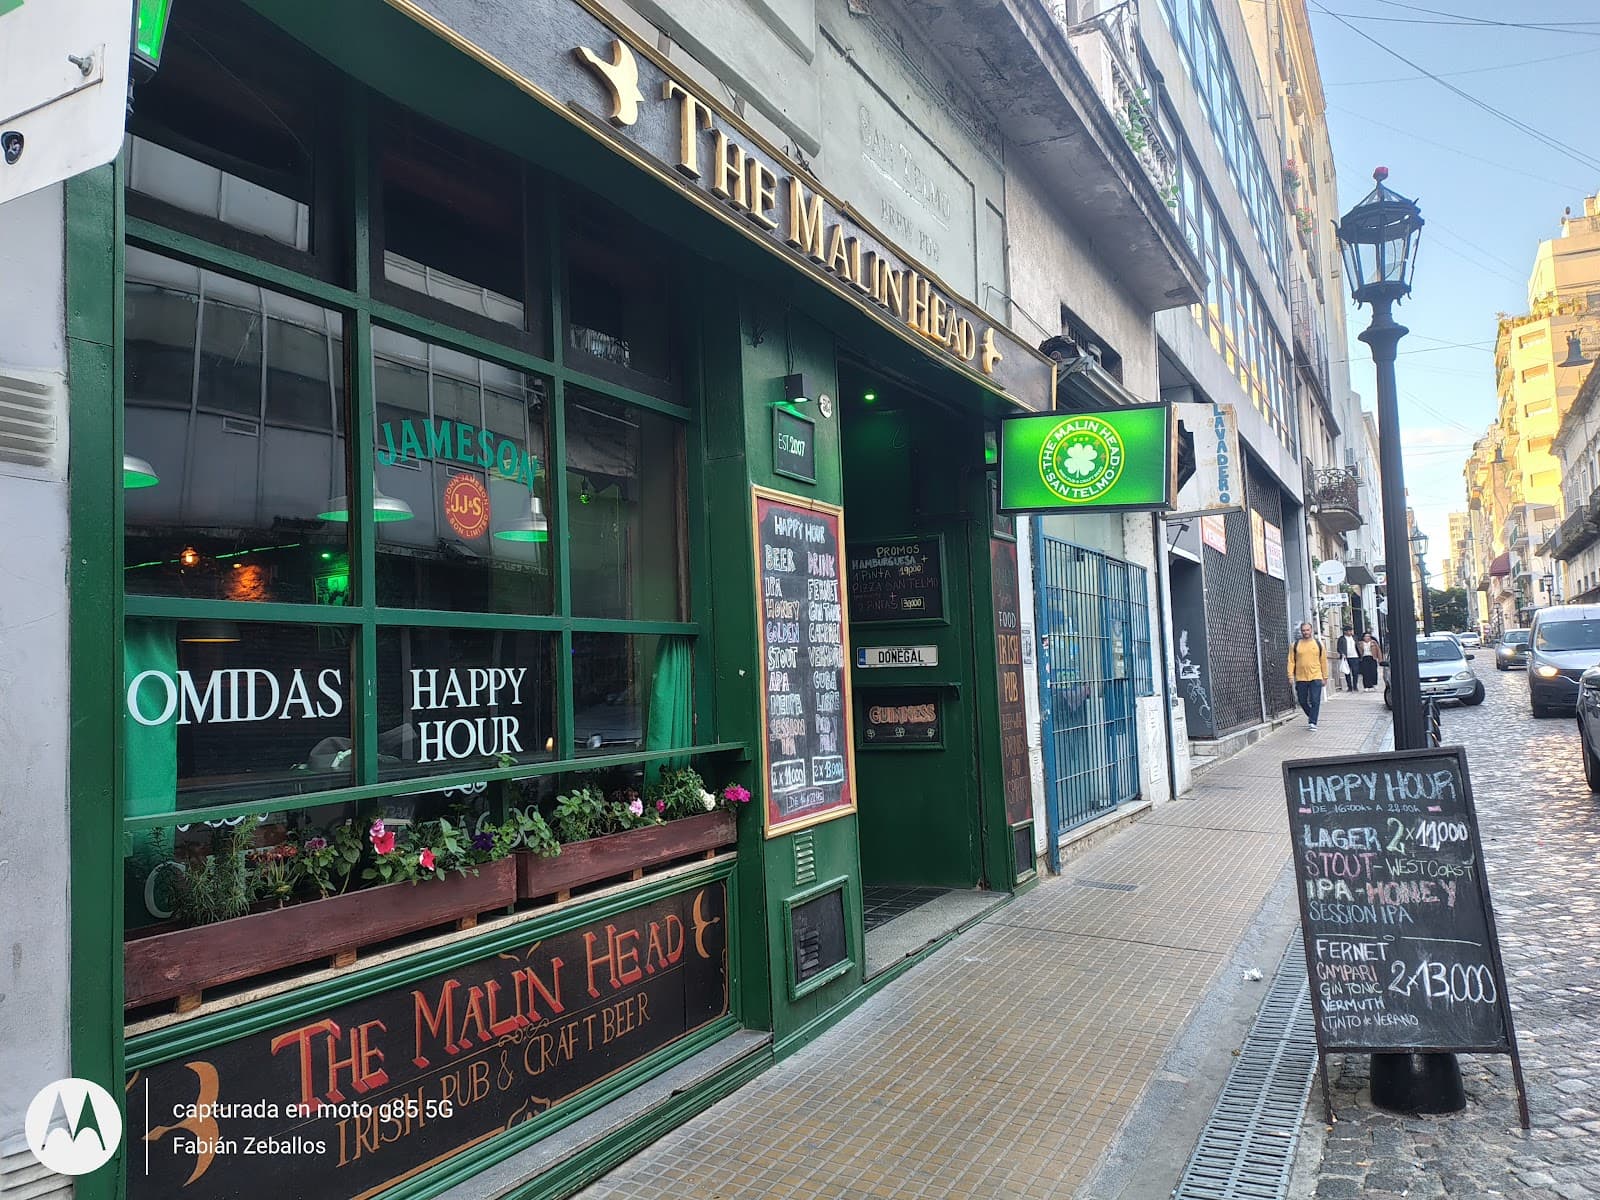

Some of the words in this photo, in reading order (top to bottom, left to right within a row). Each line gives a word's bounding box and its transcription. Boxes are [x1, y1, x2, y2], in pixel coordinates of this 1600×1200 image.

[662, 80, 778, 230] THE
[784, 175, 904, 317] MALIN
[905, 268, 976, 361] HEAD
[376, 418, 538, 491] JAMESON
[1043, 440, 1057, 470] THE
[1054, 420, 1099, 441] MALIN
[1099, 427, 1120, 466] HEAD
[1213, 403, 1231, 504] LAVADERO
[1046, 472, 1070, 496] SAN
[1072, 469, 1115, 498] TELMO
[774, 515, 803, 541] HAPPY
[805, 522, 826, 544] HOUR
[764, 543, 797, 572] BEER
[852, 555, 917, 570] HAMBURGUESA
[876, 544, 920, 558] PROMOS
[998, 611, 1017, 628] FOOD
[878, 650, 924, 663] DONEGAL
[998, 634, 1020, 665] IRISH
[123, 668, 343, 726] OMIDAS
[408, 667, 528, 711] HAPPY
[1003, 671, 1019, 703] PUB
[869, 703, 937, 724] GUINNESS
[417, 716, 524, 764] HOUR
[1297, 771, 1378, 805] HAPPY
[1383, 769, 1457, 801] HOUR
[1303, 823, 1382, 851] LAGER
[1308, 901, 1378, 925] SESSION
[1380, 905, 1415, 925] IPA
[1316, 938, 1390, 962] FERNET
[1316, 963, 1378, 983] CAMPARI
[1319, 984, 1345, 1001] GIN
[1345, 982, 1384, 995] TONIC
[1321, 998, 1386, 1014] VERMUTH
[270, 1018, 389, 1117] THE
[410, 956, 566, 1069] MALIN
[582, 913, 686, 999] HEAD
[1373, 1011, 1420, 1028] VERANO
[335, 1085, 426, 1169] IRISH
[439, 1060, 491, 1109] PUB
[497, 1048, 515, 1092] &
[602, 991, 651, 1046] BEER
